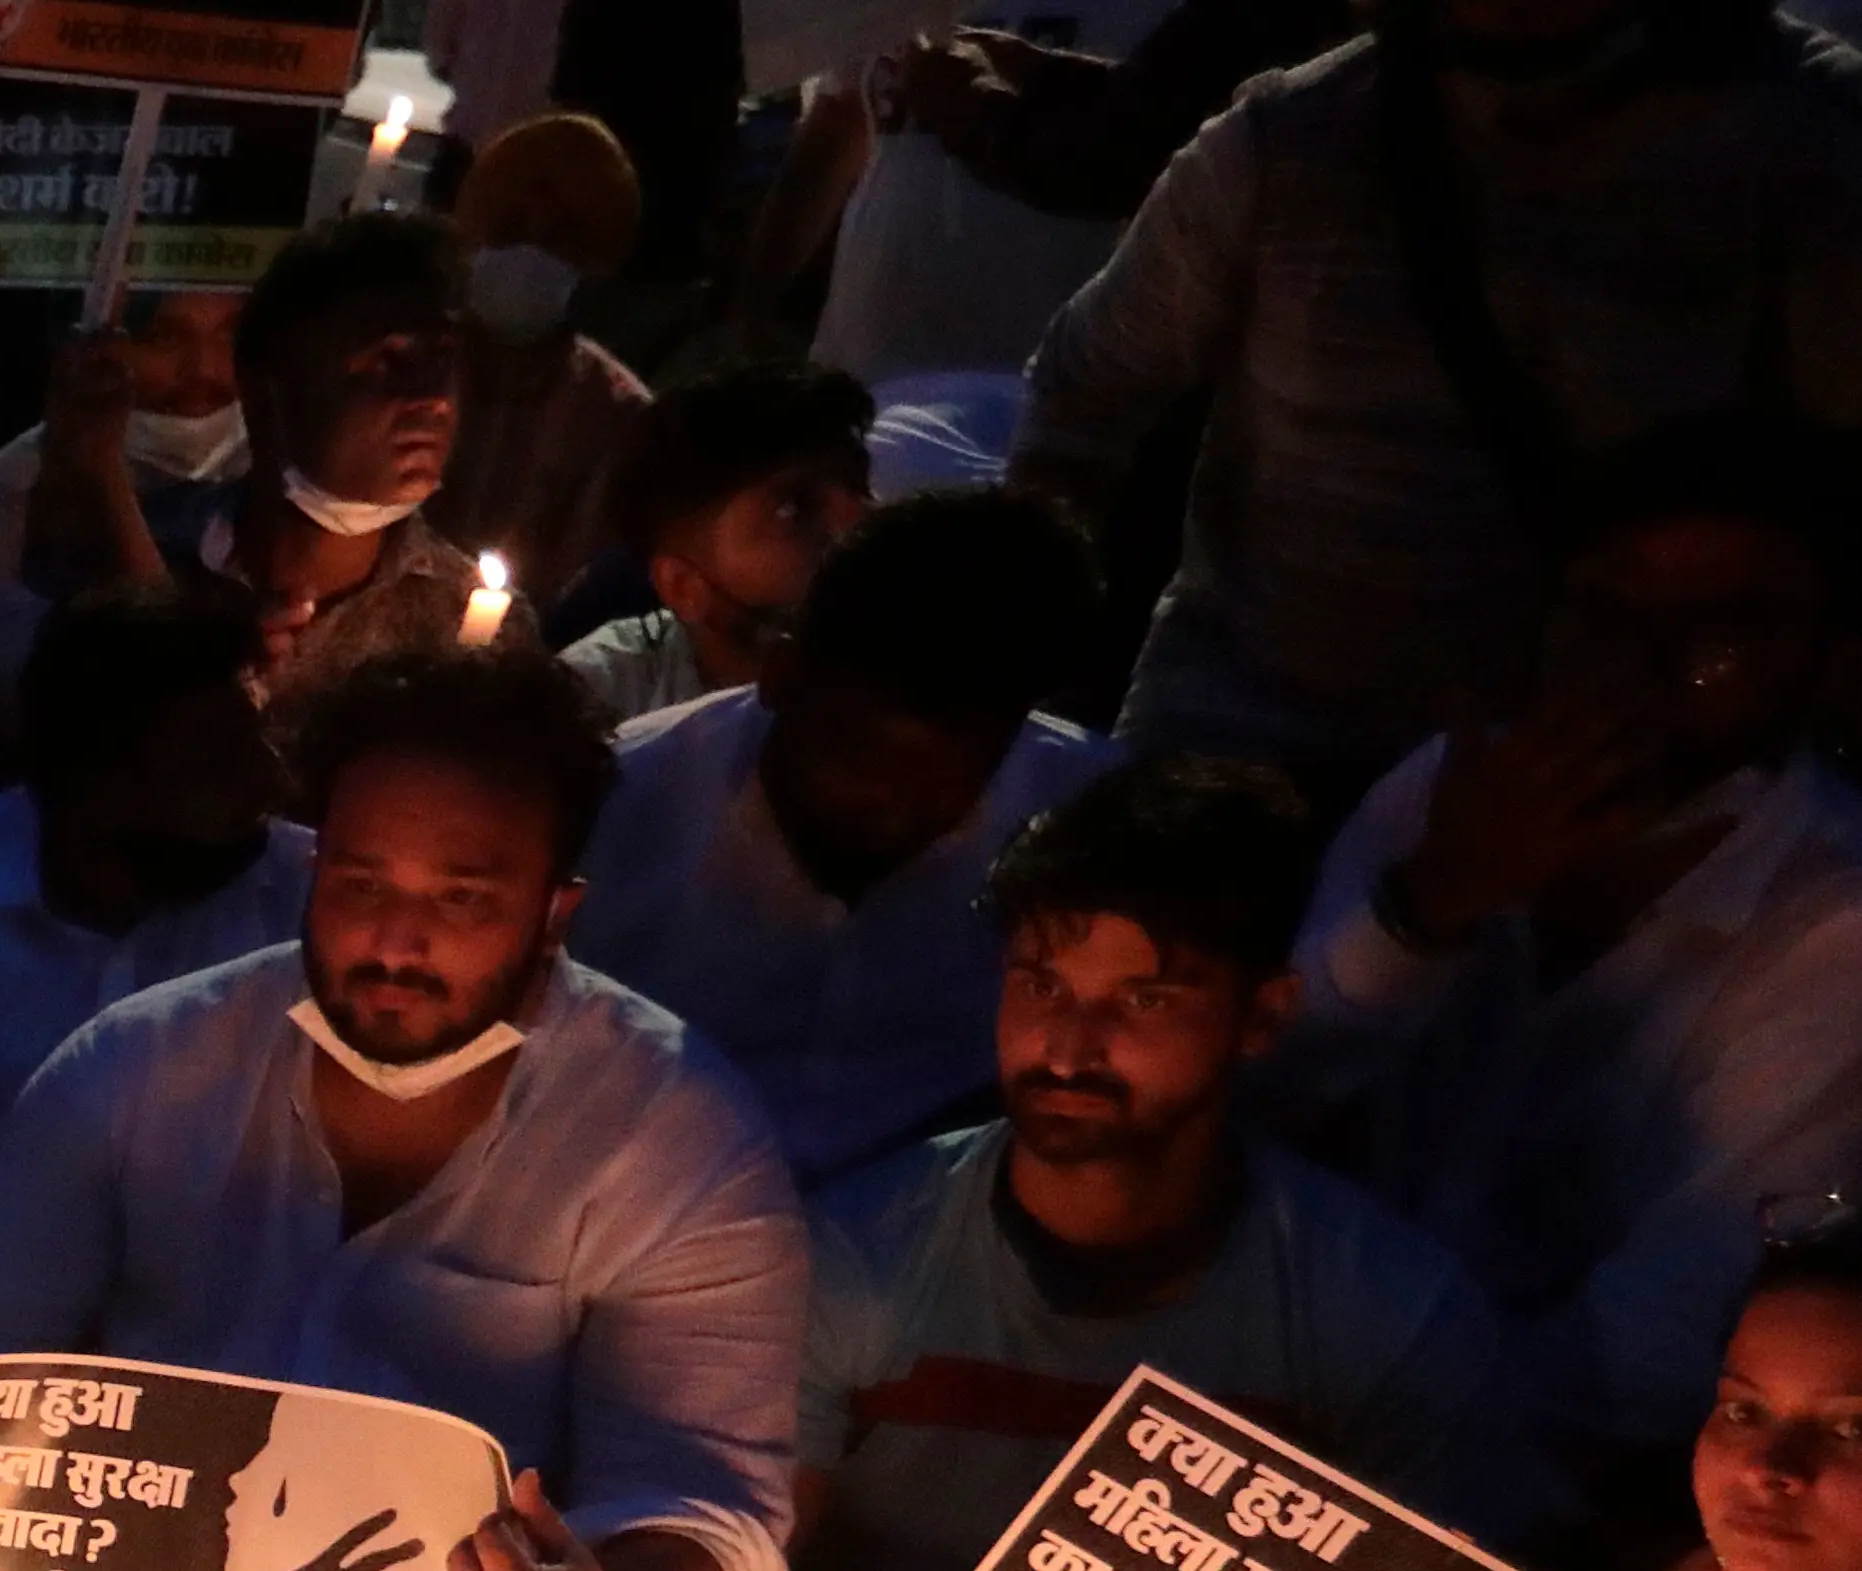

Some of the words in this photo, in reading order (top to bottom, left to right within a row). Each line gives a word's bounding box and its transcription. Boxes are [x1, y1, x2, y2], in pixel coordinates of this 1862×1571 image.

[39, 1377, 143, 1438] हुआ
[65, 1451, 195, 1509] सुरक्षा
[1126, 1404, 1247, 1498] क्या
[1225, 1461, 1371, 1565] हुआ
